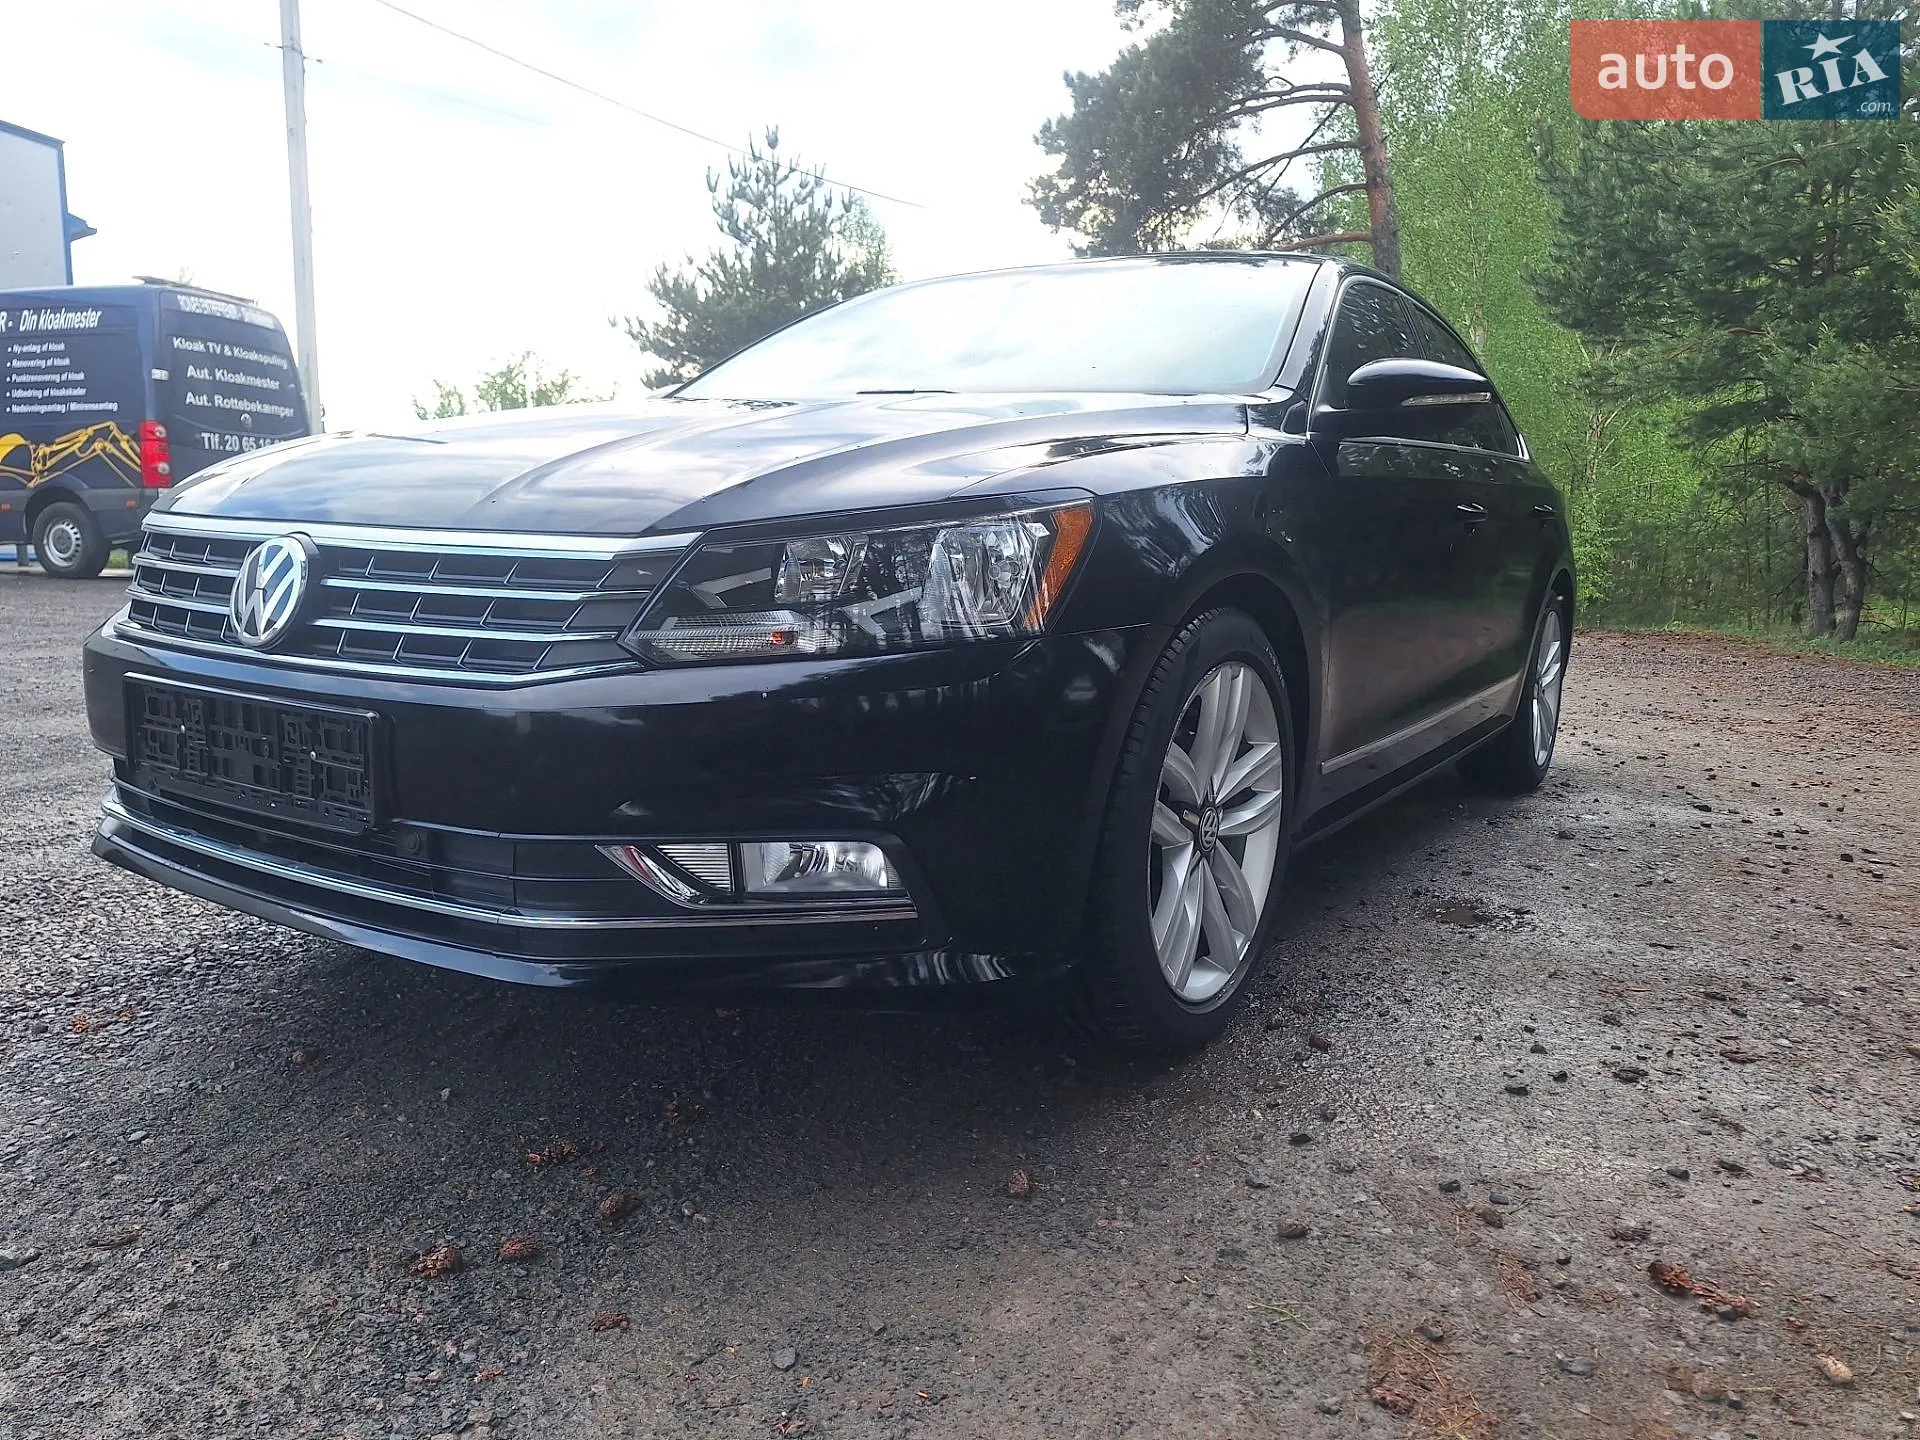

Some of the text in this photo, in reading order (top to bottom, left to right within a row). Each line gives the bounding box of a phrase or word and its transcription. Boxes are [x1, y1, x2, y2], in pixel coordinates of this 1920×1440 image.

[19, 309, 38, 332] Din
[38, 308, 103, 331] kloakmester
[172, 336, 206, 352] Kloak
[207, 342, 221, 354] TV
[224, 345, 232, 356] &
[186, 365, 280, 390] Aut. Kloakmester
[185, 392, 212, 406] Aut.
[201, 433, 224, 450] Tlf.
[225, 435, 239, 452] 20
[242, 437, 256, 451] 65
